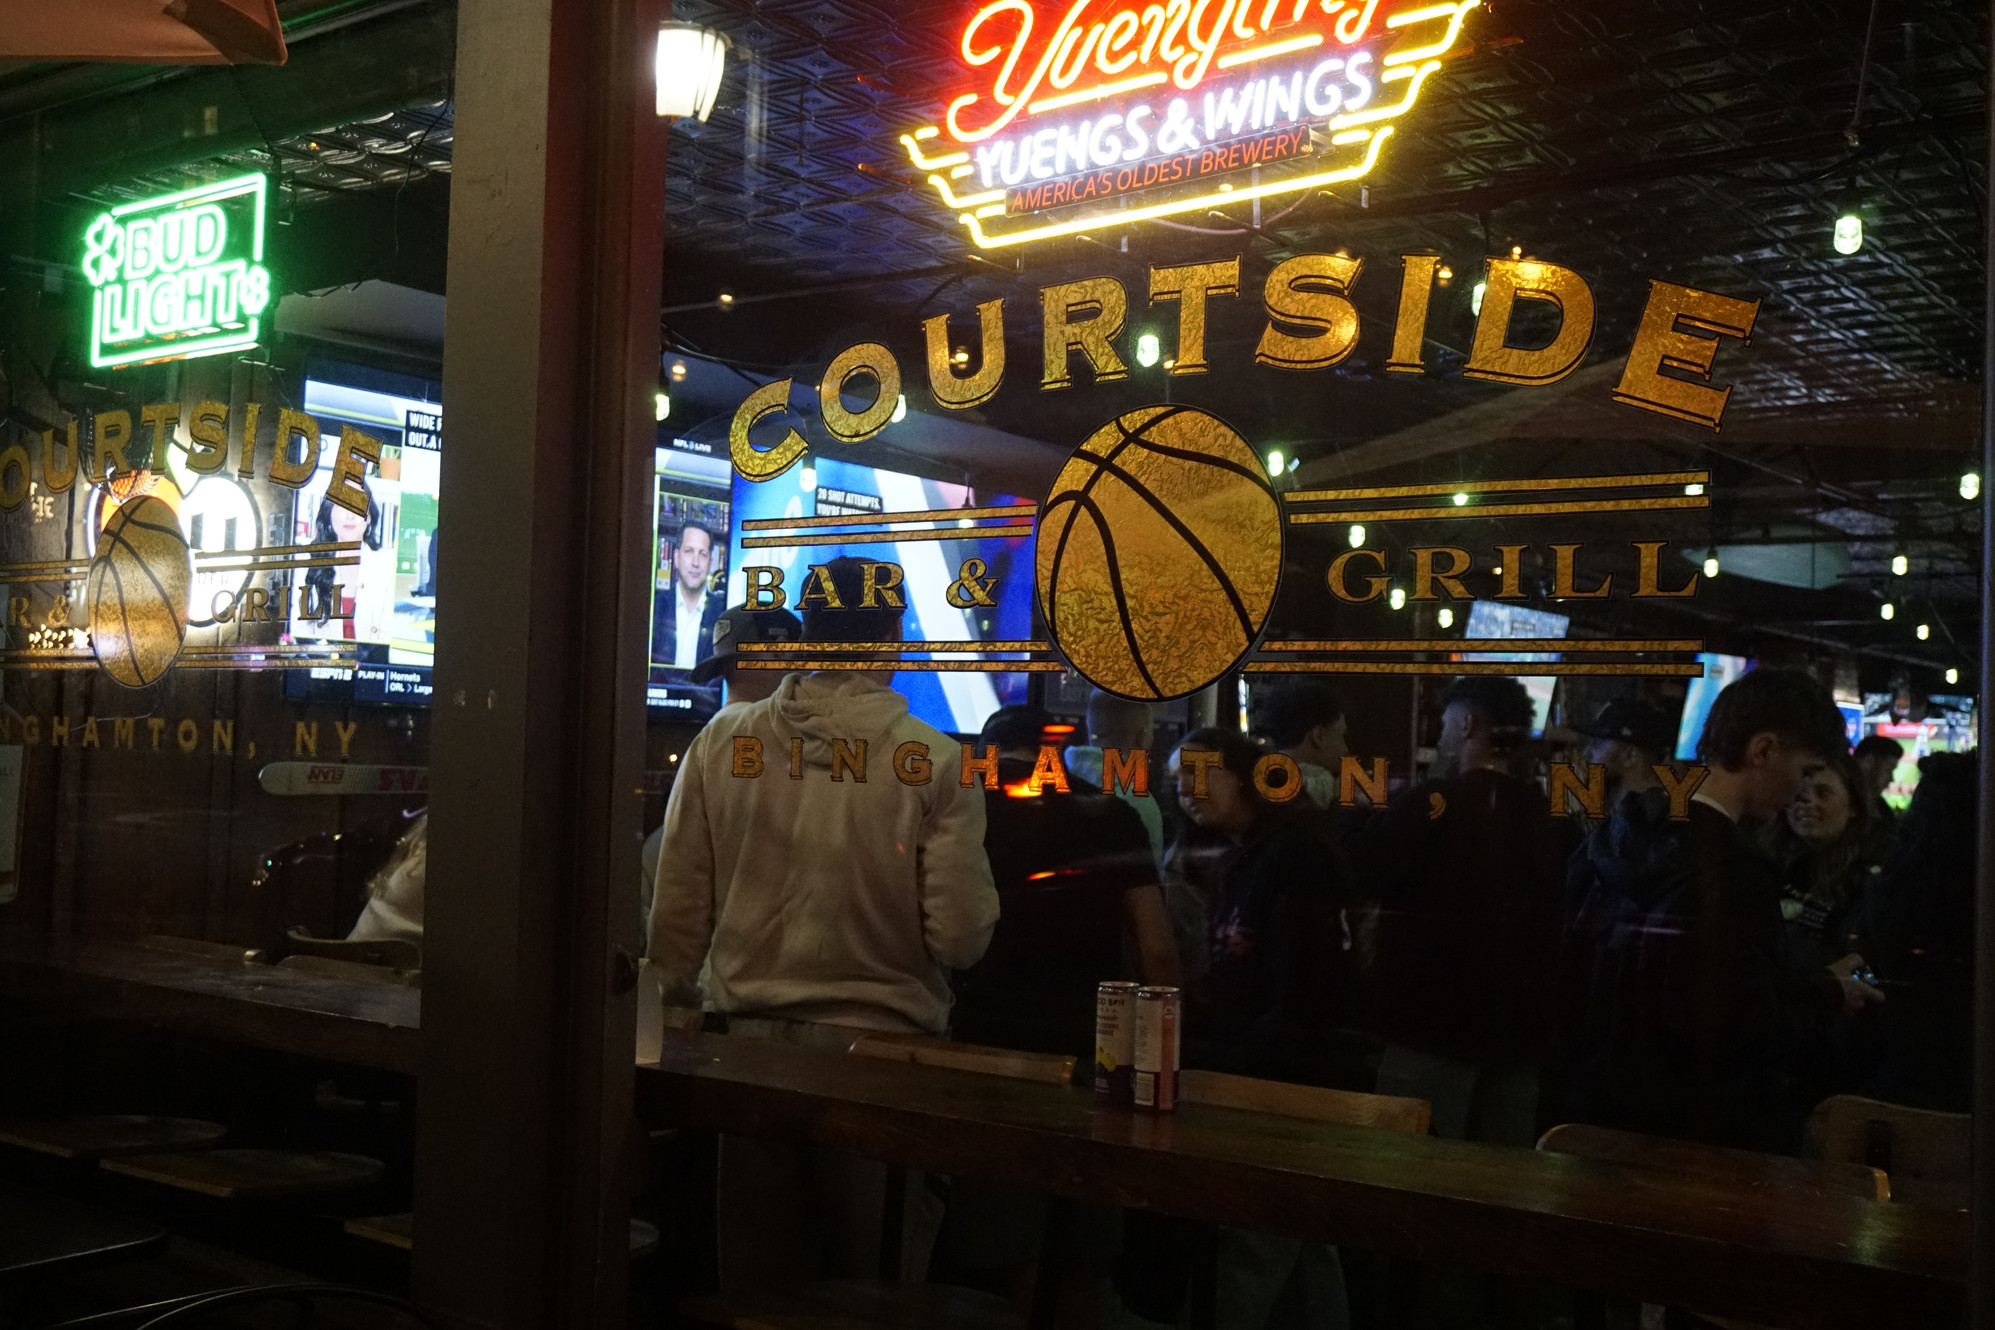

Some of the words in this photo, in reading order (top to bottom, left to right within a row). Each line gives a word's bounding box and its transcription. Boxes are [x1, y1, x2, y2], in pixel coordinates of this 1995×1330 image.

[946, 0, 1380, 142] Yueng
[975, 104, 1152, 188] YUENGS
[1156, 97, 1201, 154] &
[1203, 51, 1377, 141] WINGS
[1010, 173, 1113, 213] AMERICA'S
[1115, 157, 1198, 195] OLDEST
[1200, 133, 1305, 172] BREWERY
[123, 203, 228, 280] BUD
[101, 259, 246, 344] LIGHT
[729, 252, 1763, 483] COURTSIDE
[0, 401, 385, 521] OURTSIDE
[409, 411, 436, 431] WIDE
[211, 584, 357, 625] GRILL
[741, 562, 907, 612] BAR
[945, 557, 999, 609] &
[1326, 540, 1700, 602] GRILL
[390, 671, 421, 683] Hornets
[0, 714, 256, 761] GHAMTON,
[295, 721, 358, 759] NY
[732, 735, 1447, 821] BINGHAMTON,
[1550, 761, 1711, 822] NY
